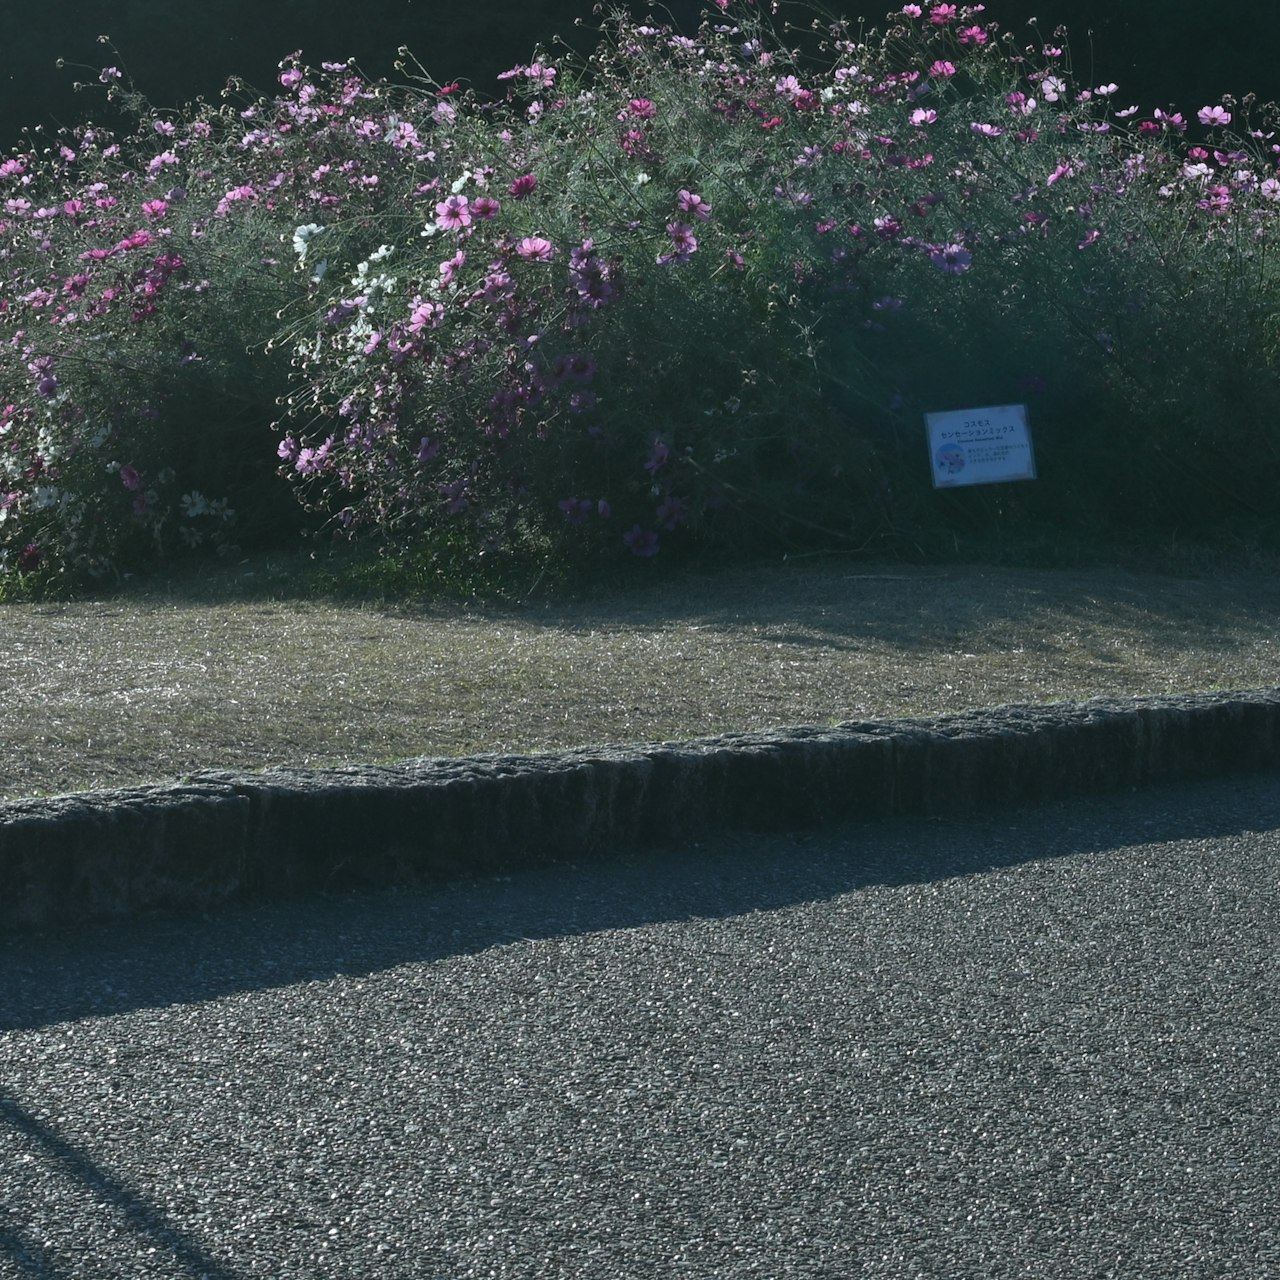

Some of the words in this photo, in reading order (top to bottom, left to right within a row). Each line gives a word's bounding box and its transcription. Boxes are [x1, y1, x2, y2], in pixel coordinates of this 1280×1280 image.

[964, 420, 991, 428] コスモス
[941, 426, 1015, 439] センセーションミックス
